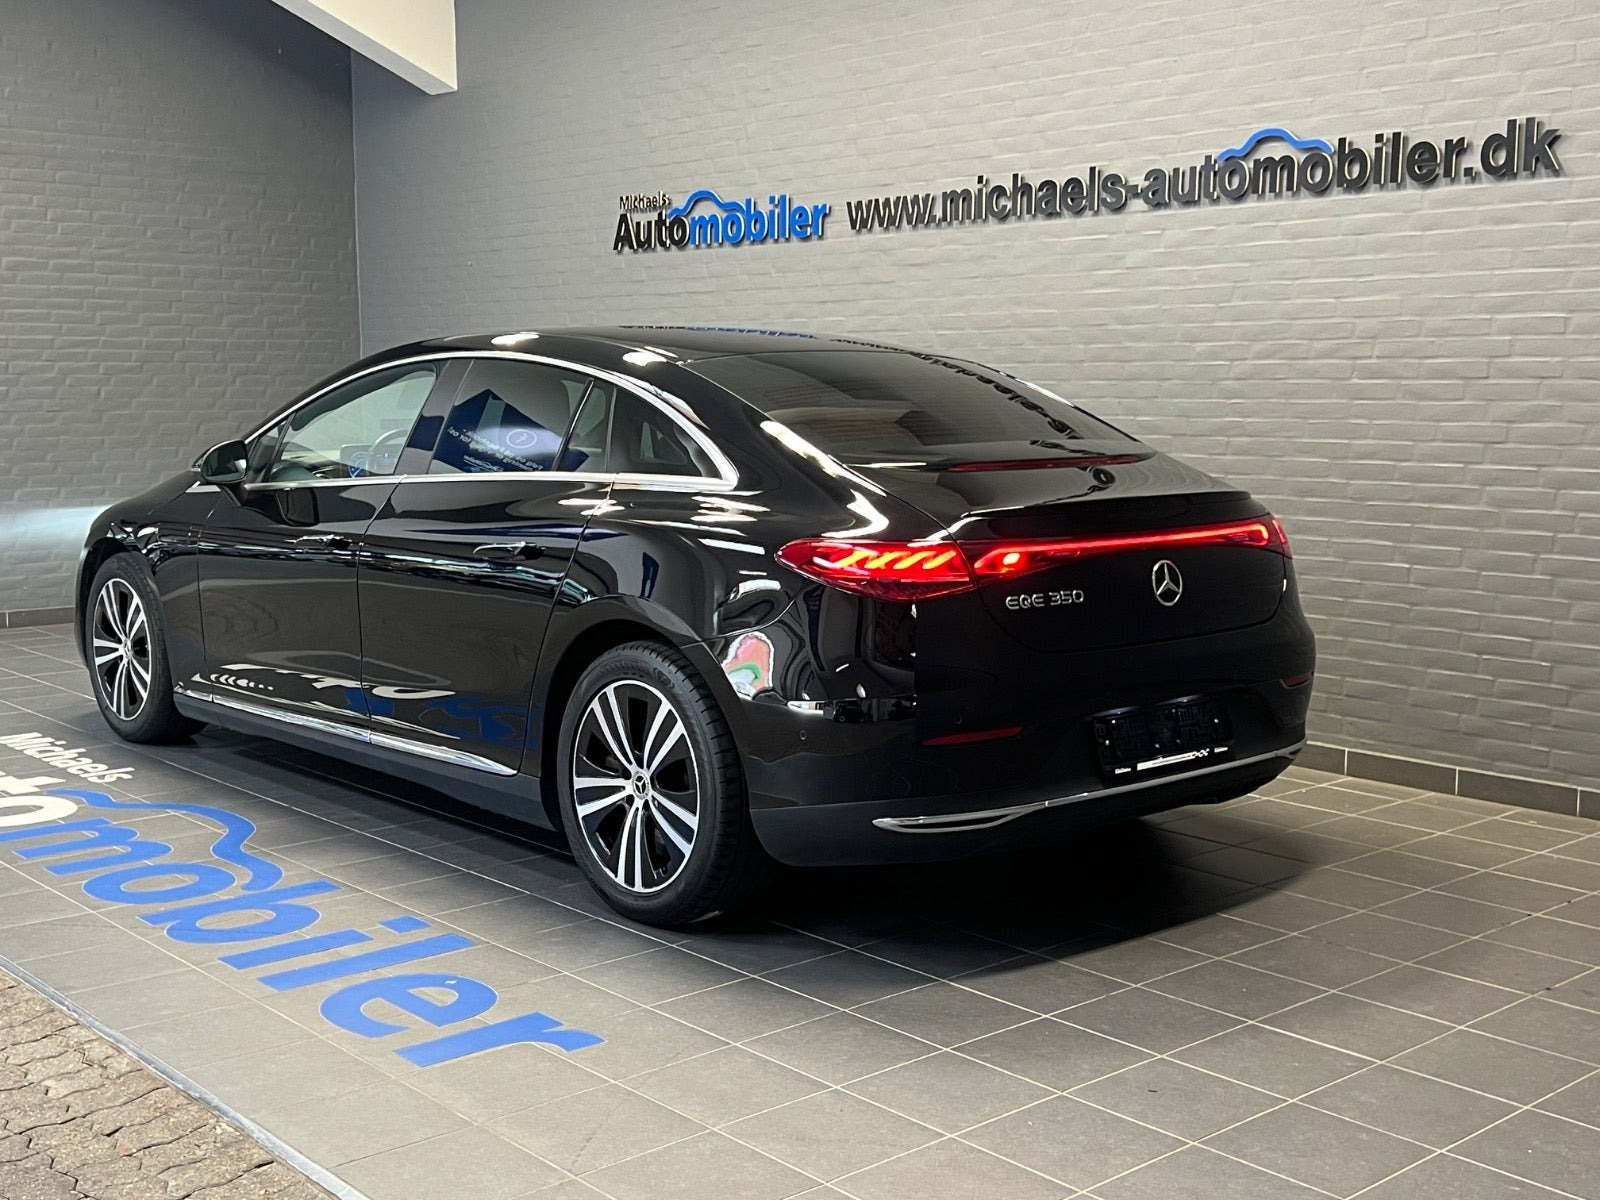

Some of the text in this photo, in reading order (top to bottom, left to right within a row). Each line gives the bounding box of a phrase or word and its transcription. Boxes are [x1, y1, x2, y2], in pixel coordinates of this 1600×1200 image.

[846, 116, 1562, 232] www.michaels-automobiler.dk
[619, 191, 669, 210] Michaels
[613, 194, 830, 251] Automobiler
[1005, 589, 1085, 610] EQE 350
